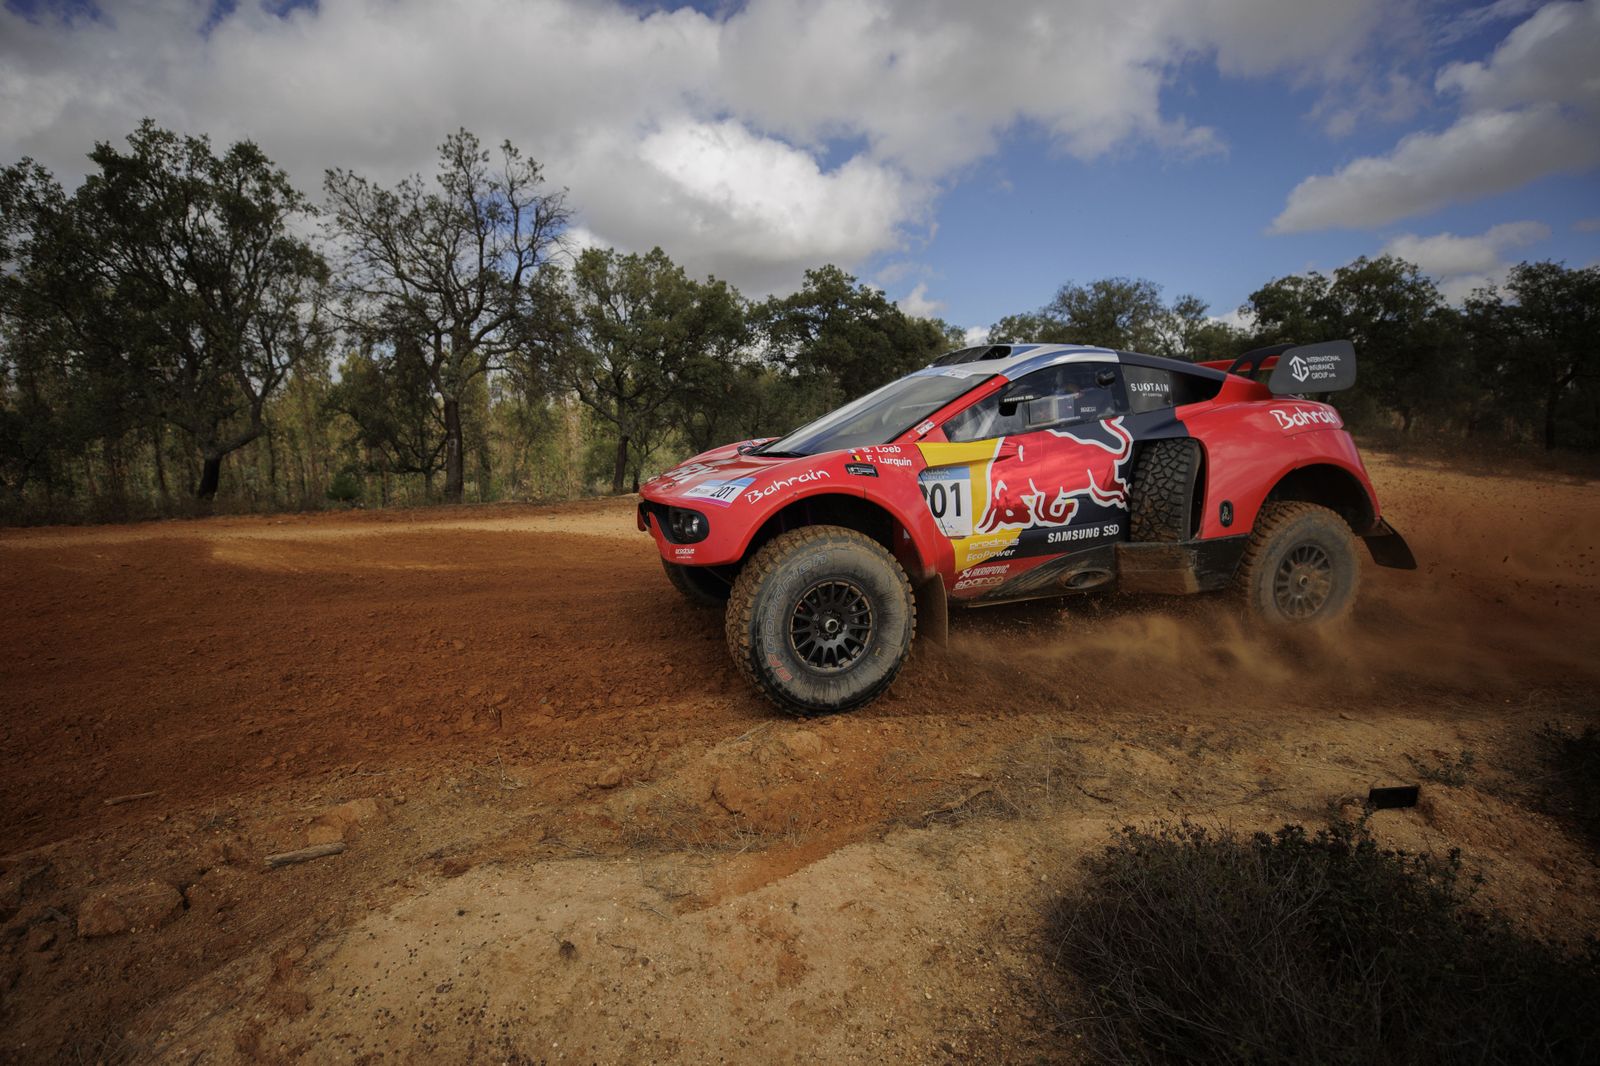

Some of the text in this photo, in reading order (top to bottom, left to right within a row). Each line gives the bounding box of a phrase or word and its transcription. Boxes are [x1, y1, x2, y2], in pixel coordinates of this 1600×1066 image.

[1311, 371, 1328, 379] GROUP
[1269, 406, 1338, 430] Bahrain
[866, 455, 912, 467] F. Lurquin
[745, 469, 830, 504] Bahrain
[1047, 524, 1120, 543] SAMSUNG SSD
[966, 549, 1016, 562] EcoPower
